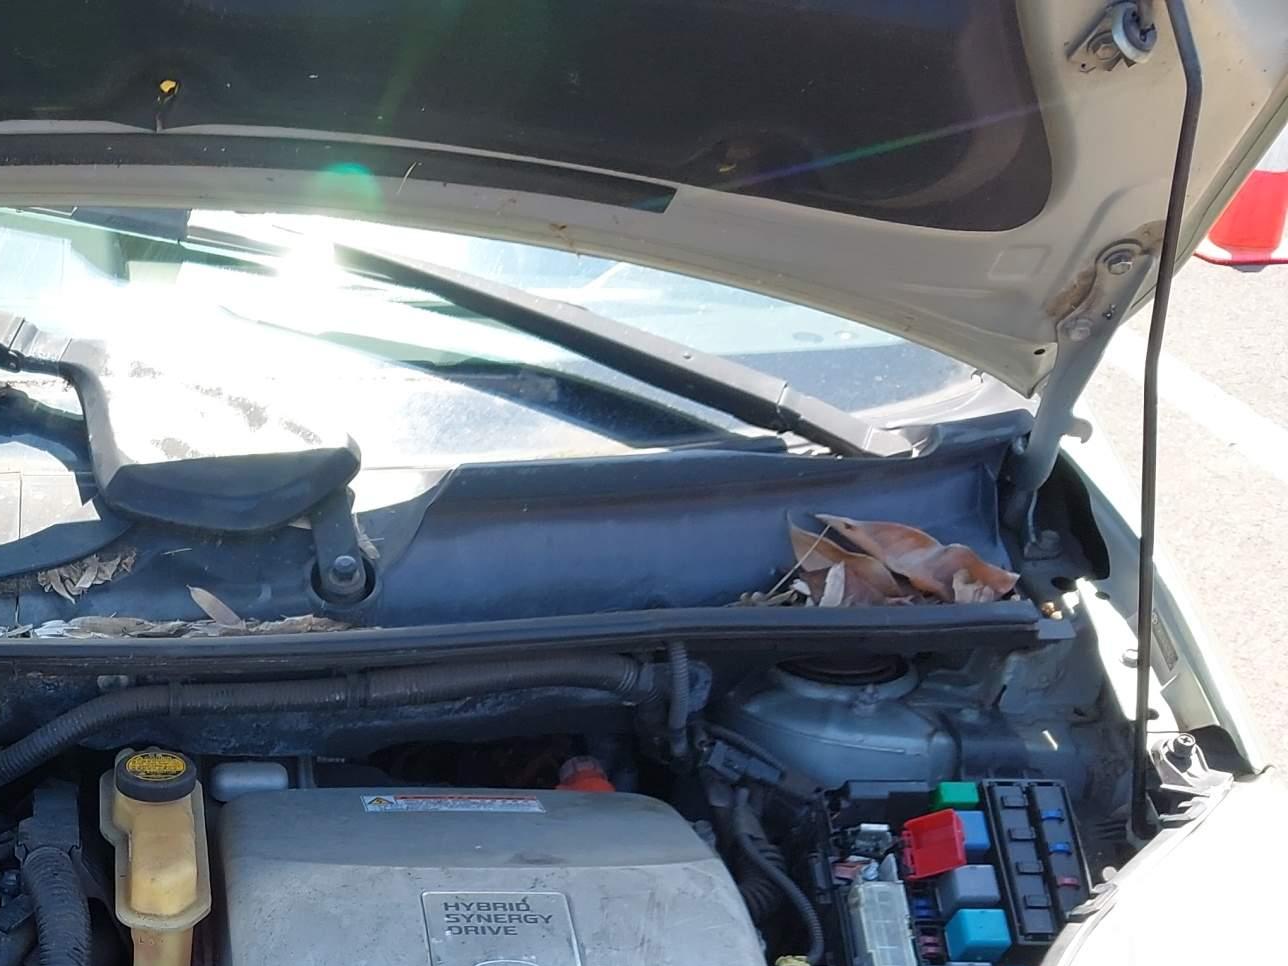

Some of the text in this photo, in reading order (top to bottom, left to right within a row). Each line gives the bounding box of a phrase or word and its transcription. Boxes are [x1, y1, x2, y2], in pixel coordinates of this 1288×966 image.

[443, 901, 531, 912] HYBRID
[444, 913, 554, 925] SYNERGY
[446, 926, 519, 936] DRIVE
